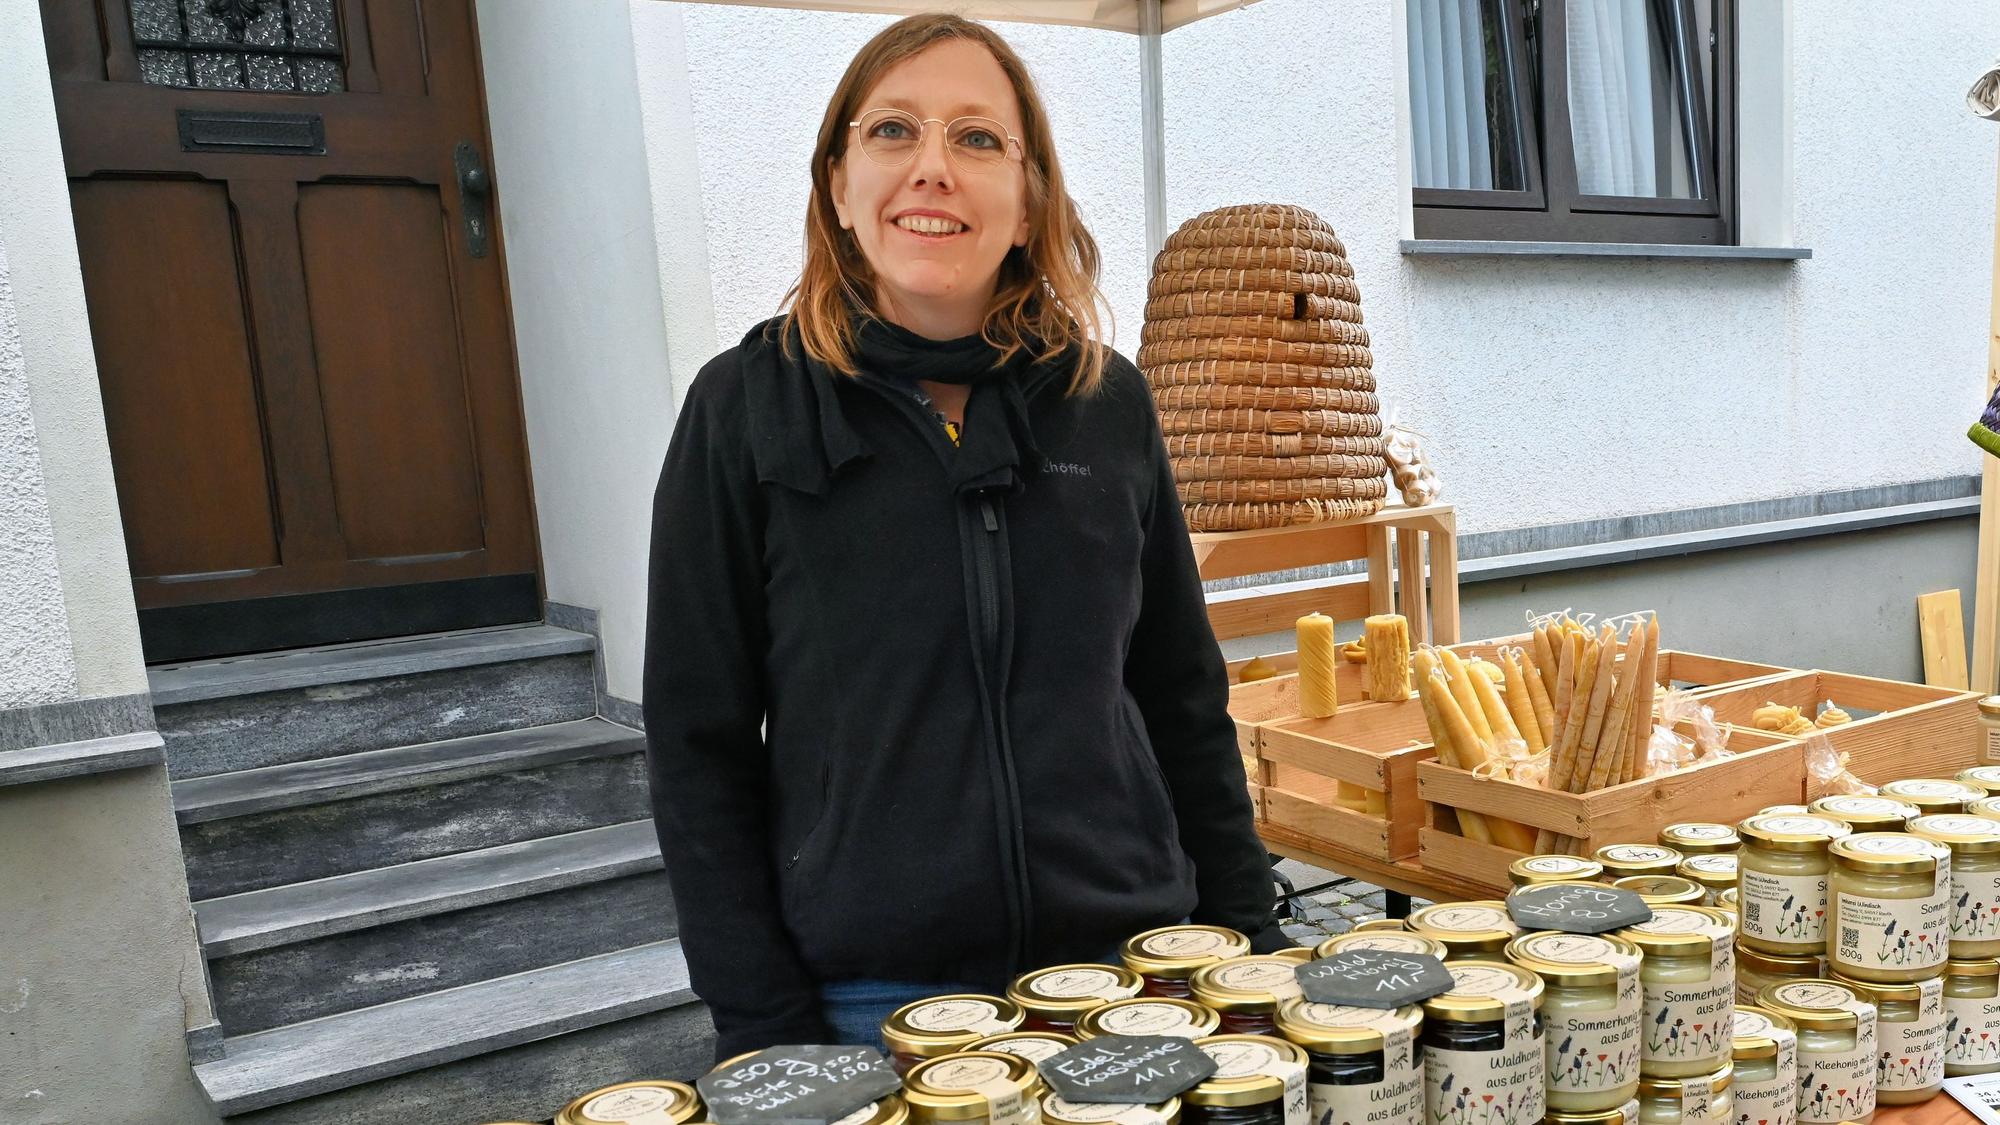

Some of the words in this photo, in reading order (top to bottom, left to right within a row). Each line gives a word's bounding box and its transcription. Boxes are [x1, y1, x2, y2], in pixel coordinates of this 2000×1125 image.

[1518, 887, 1619, 917] Honig
[1744, 920, 1763, 935] 500g
[1922, 919, 1938, 930] aus
[1840, 947, 1862, 963] 500g
[1696, 1004, 1714, 1016] aus
[1600, 1033, 1620, 1045] aus
[1904, 1042, 1922, 1054] aus
[1814, 1057, 1859, 1071] Kleehonig
[1486, 1077, 1508, 1089] aus
[1509, 1070, 1528, 1086] der
[1851, 1069, 1865, 1079] aus
[1683, 1088, 1710, 1098] Windisch
[1735, 1086, 1779, 1100] Kleehonig
[1772, 1098, 1785, 1109] aus
[1367, 1109, 1388, 1122] aus
[1391, 1102, 1409, 1118] der
